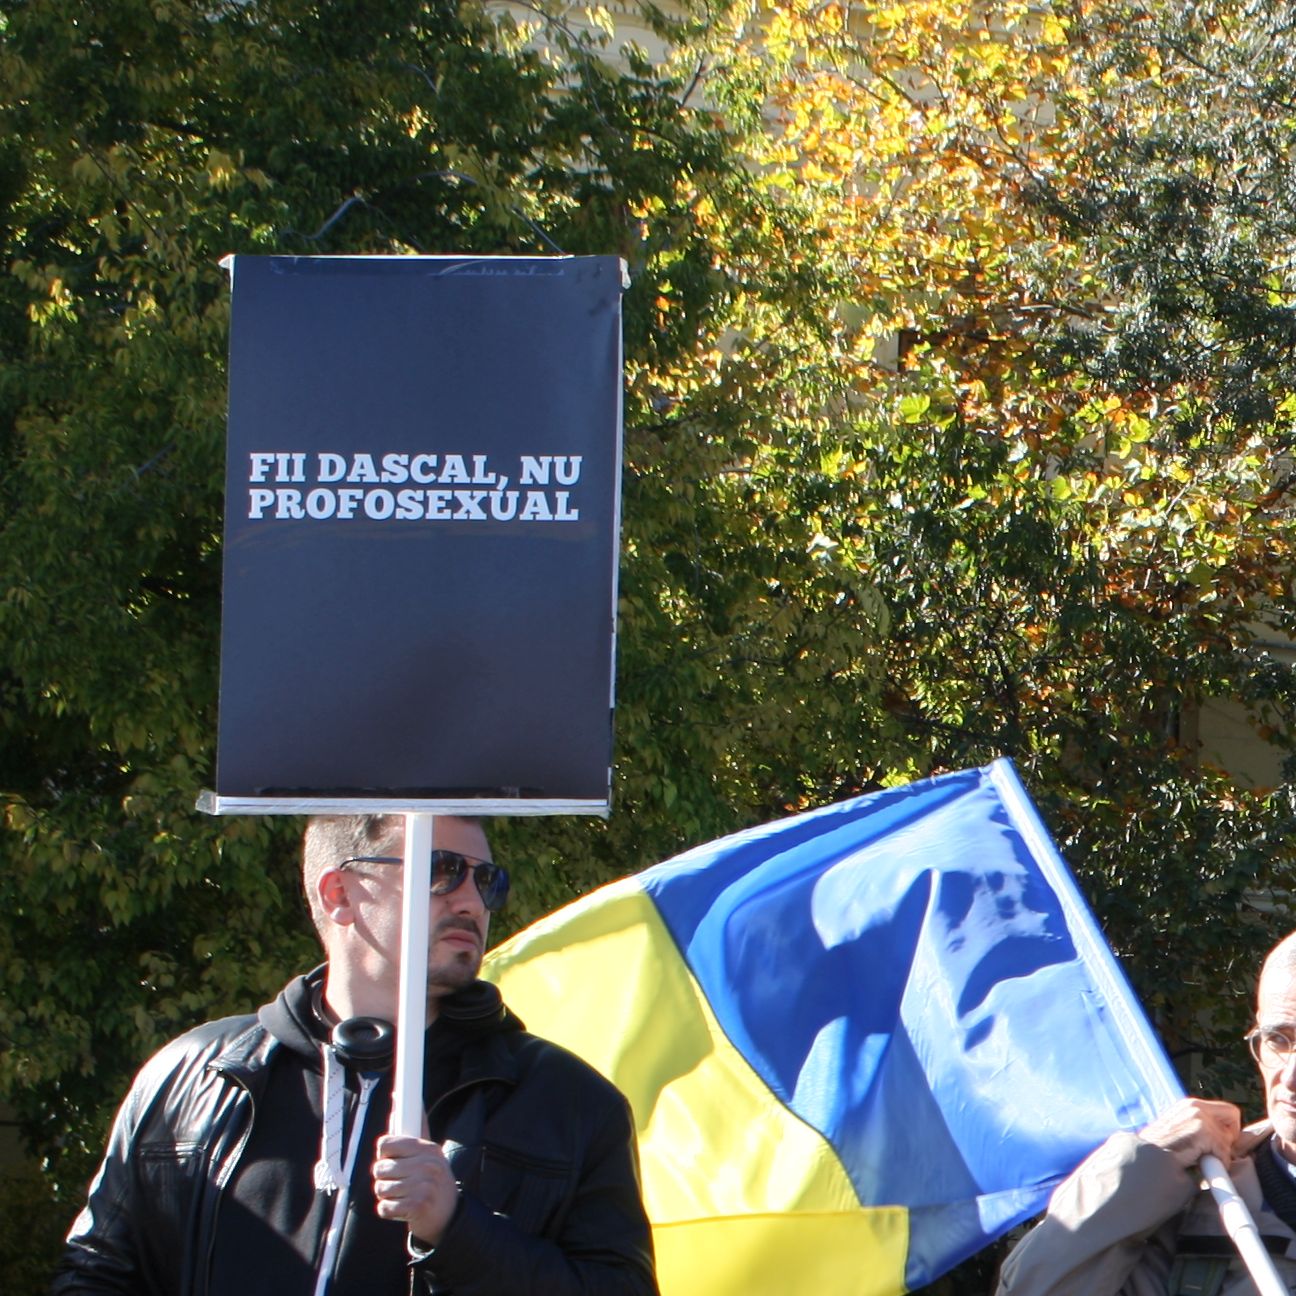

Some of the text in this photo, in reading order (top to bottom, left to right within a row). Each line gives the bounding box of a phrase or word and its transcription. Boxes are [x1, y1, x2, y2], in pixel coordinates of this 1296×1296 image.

[249, 452, 583, 491] FII DASCAL, NU
[248, 487, 579, 521] PROFOSEXUAL
